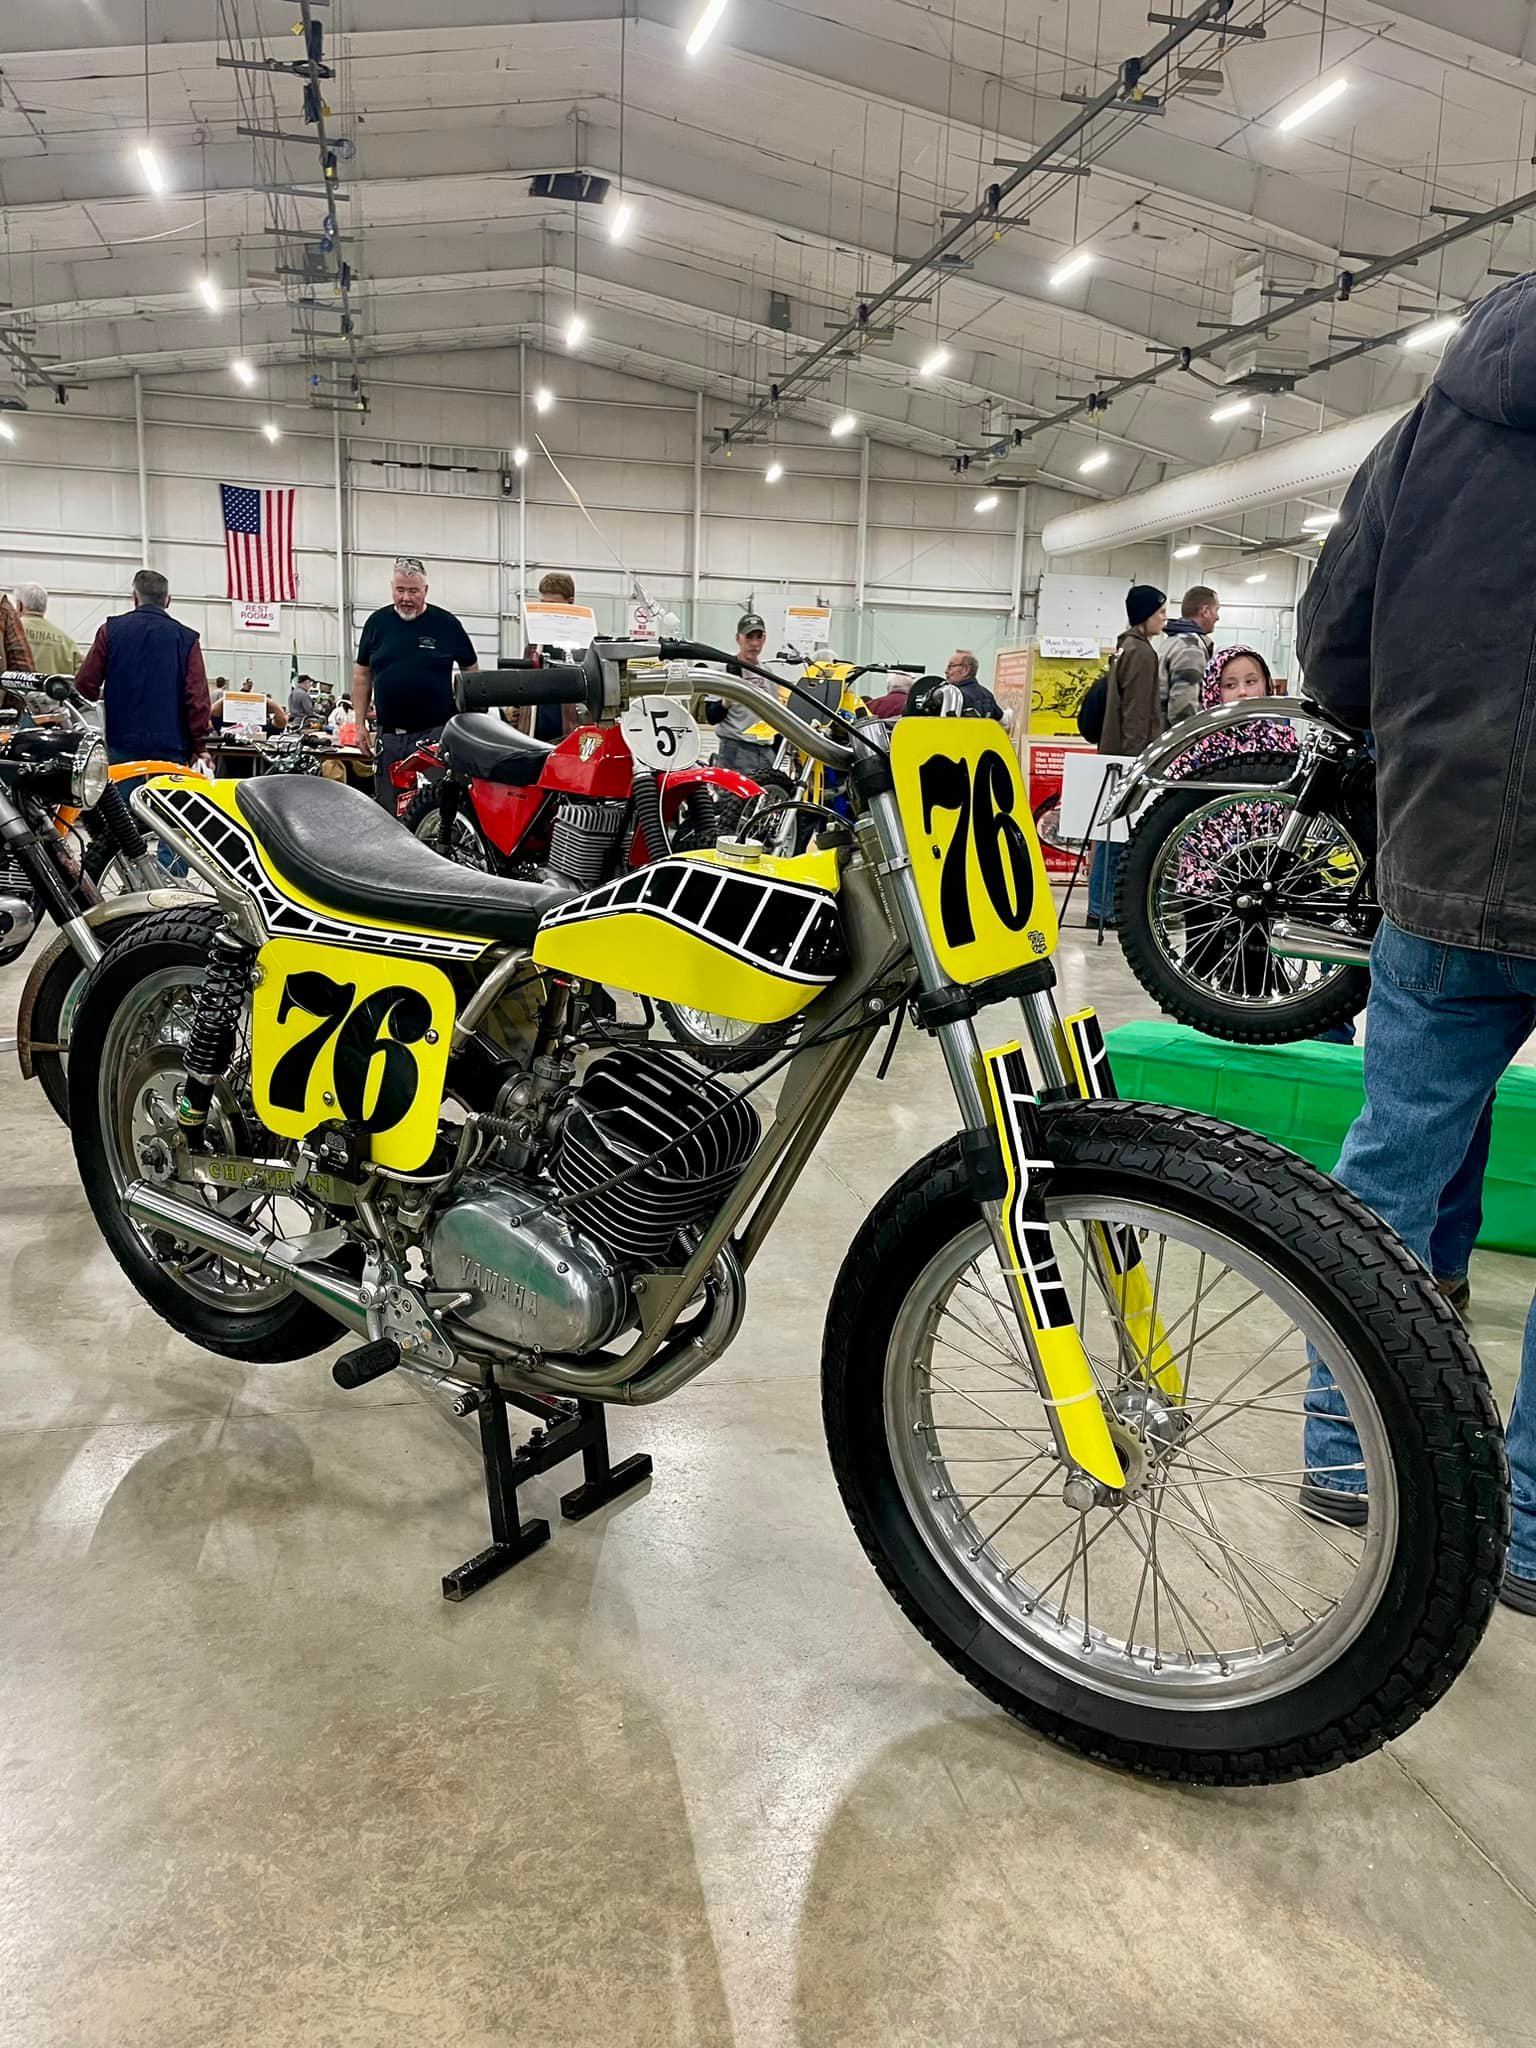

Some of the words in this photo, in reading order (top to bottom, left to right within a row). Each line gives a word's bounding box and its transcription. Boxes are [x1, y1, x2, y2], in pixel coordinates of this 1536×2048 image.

[240, 611, 274, 620] ROOMS
[245, 604, 268, 612] REST
[650, 710, 677, 757] 5
[919, 749, 1035, 949] 76
[268, 970, 434, 1135] 76
[460, 1255, 537, 1317] YAMAHA
